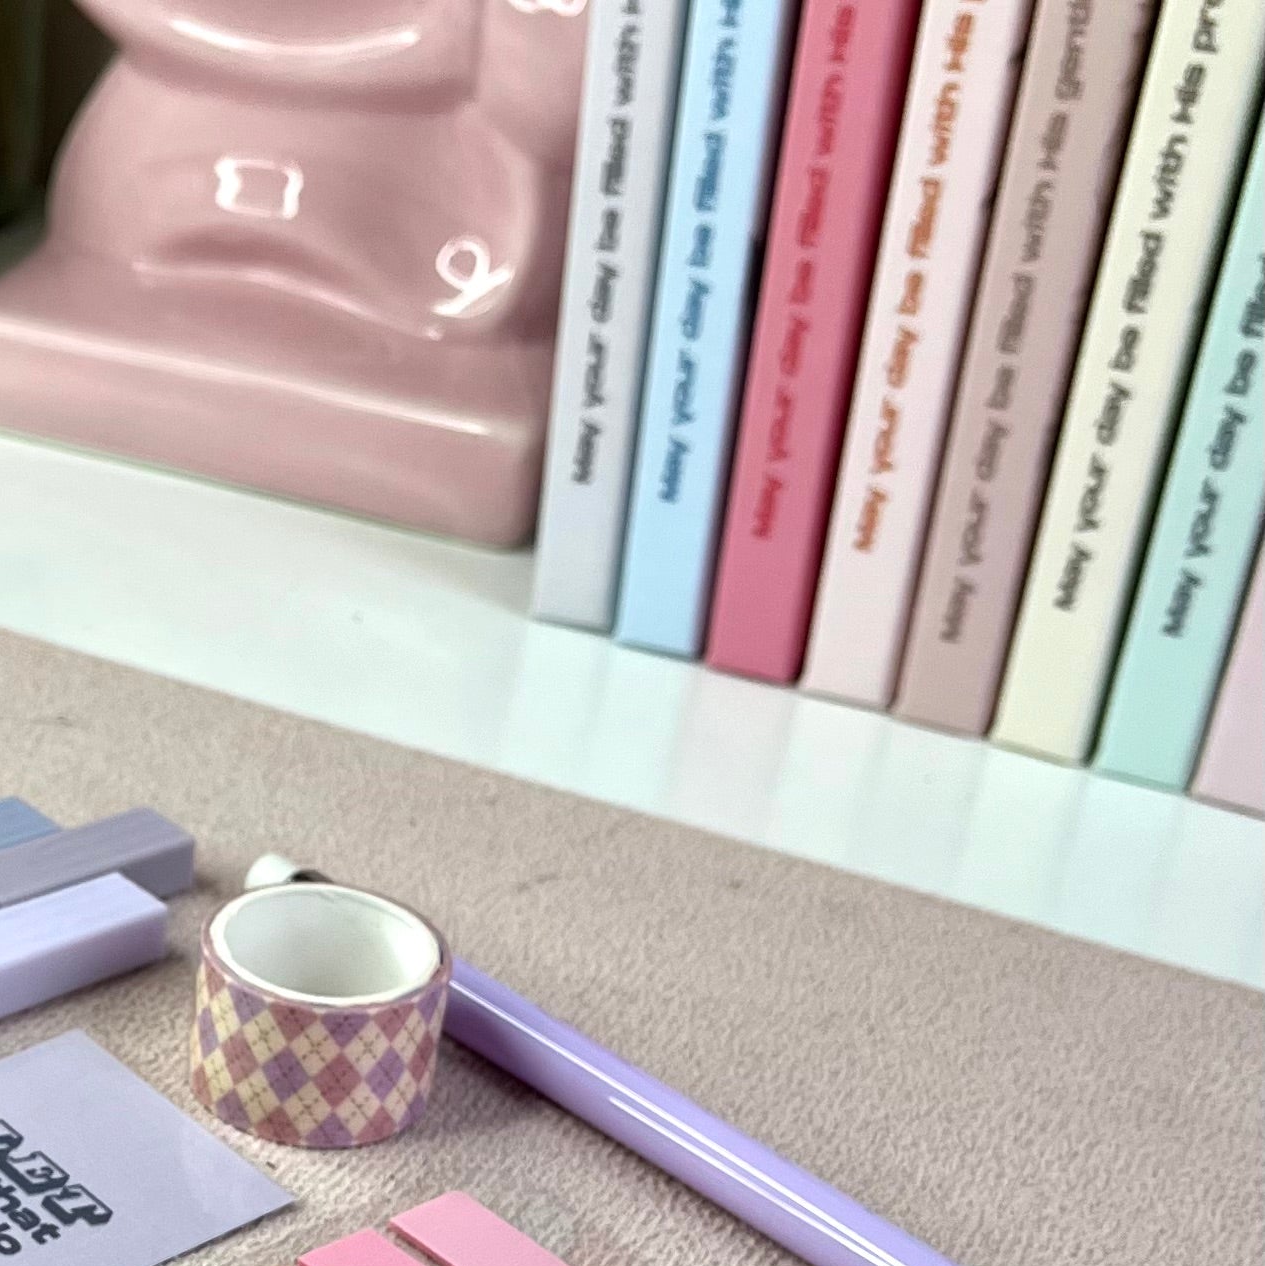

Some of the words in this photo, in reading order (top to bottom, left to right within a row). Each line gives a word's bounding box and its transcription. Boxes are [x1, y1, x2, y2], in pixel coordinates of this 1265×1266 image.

[614, 25, 639, 106] with
[710, 37, 737, 120] with
[601, 117, 630, 196] filled
[928, 81, 961, 166] with
[693, 131, 727, 212] filled
[1149, 133, 1189, 221] with
[595, 209, 621, 252] be
[686, 222, 714, 267] be
[906, 175, 944, 260] filled
[1020, 178, 1055, 263] with
[589, 261, 620, 324] day
[680, 276, 712, 340] day
[897, 268, 927, 317] be
[1122, 229, 1165, 315] filled
[995, 271, 1036, 355] filled
[582, 331, 606, 408] your
[885, 323, 921, 390] day
[1108, 326, 1141, 374] be
[1224, 348, 1259, 398] be
[671, 348, 698, 426] your
[986, 364, 1018, 411] be
[1093, 380, 1132, 448] day
[571, 417, 602, 485] May
[658, 434, 691, 504] May
[871, 395, 901, 475] your
[975, 416, 1012, 484] day
[1208, 404, 1248, 473] day
[853, 483, 889, 555] May
[956, 485, 990, 568] your
[1074, 452, 1109, 534] your
[1183, 476, 1221, 560] your
[939, 576, 977, 645] May
[1052, 540, 1093, 612] May
[1160, 565, 1204, 640] May
